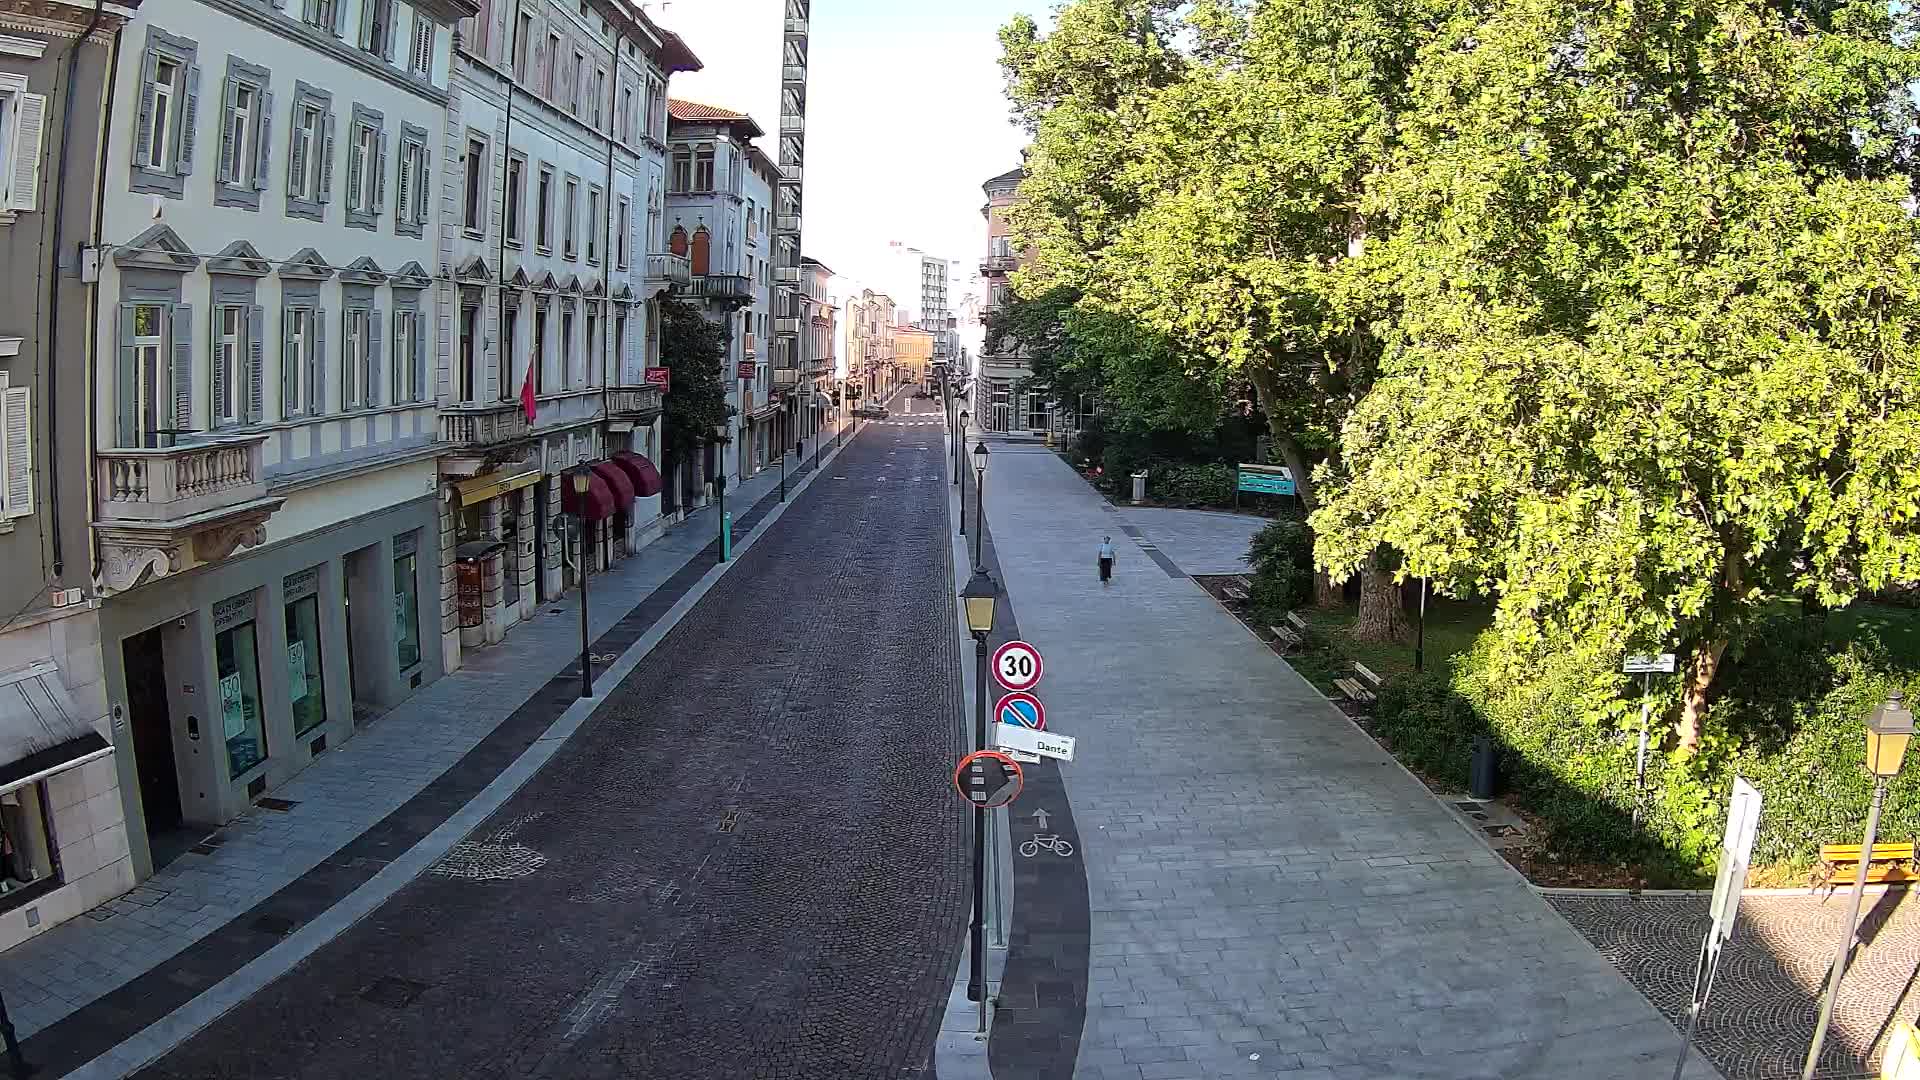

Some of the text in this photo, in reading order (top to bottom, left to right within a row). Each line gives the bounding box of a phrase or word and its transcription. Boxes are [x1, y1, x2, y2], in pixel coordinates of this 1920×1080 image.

[1004, 655, 1032, 677] 30
[221, 676, 239, 699] 130
[1037, 741, 1068, 755] Dante
